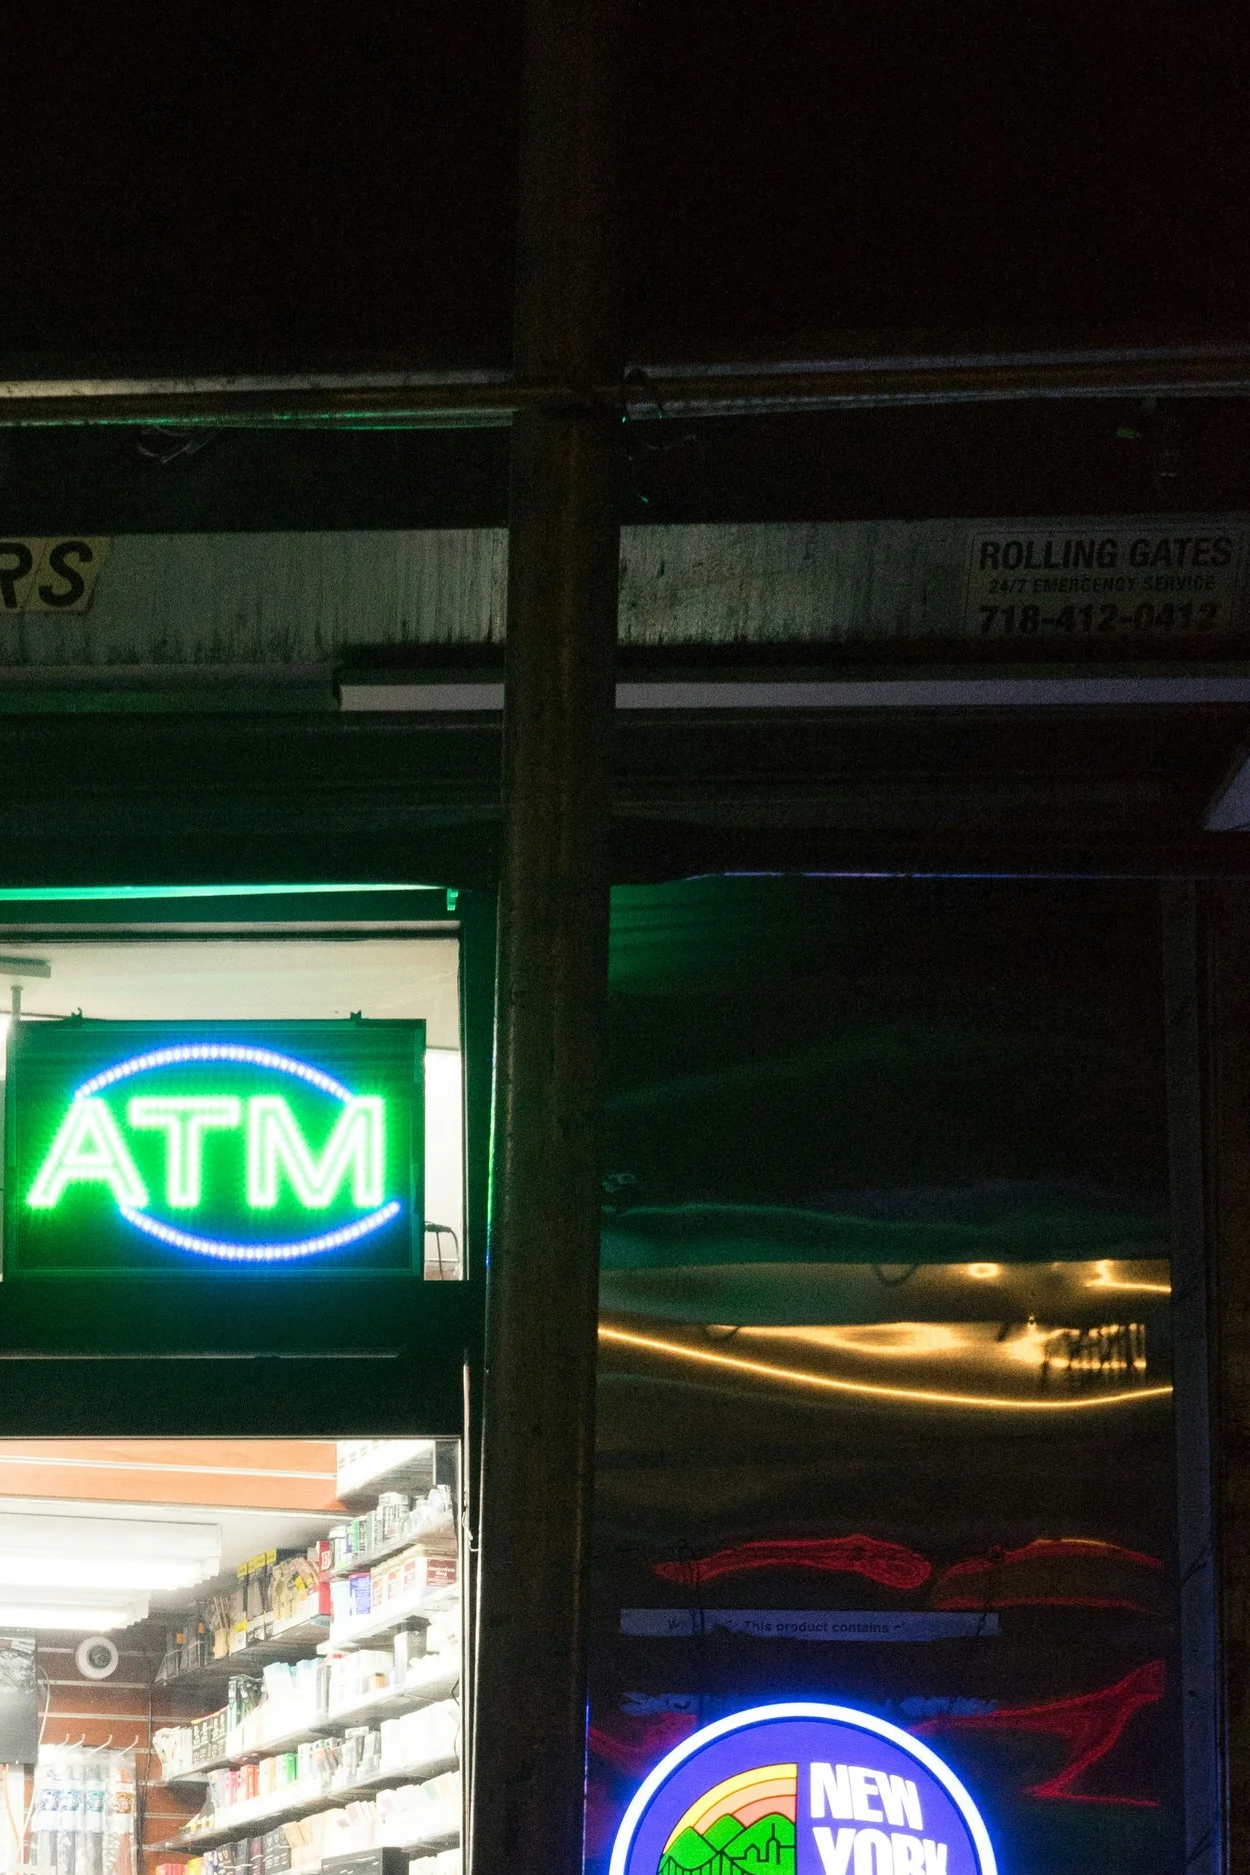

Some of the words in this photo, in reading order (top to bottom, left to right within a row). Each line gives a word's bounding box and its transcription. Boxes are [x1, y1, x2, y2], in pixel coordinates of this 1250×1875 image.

[979, 538, 1118, 570] ROLLING
[1129, 536, 1233, 569] GATES
[989, 578, 1027, 595] 24/7
[1033, 576, 1137, 594] EMERGENCY
[1142, 575, 1217, 592] SERVICE
[978, 601, 1220, 635] 718-412-0412
[28, 1096, 387, 1209] ATM
[743, 1620, 771, 1633] This
[776, 1621, 828, 1635] product
[832, 1621, 889, 1634] contains
[810, 1761, 924, 1830] NEW
